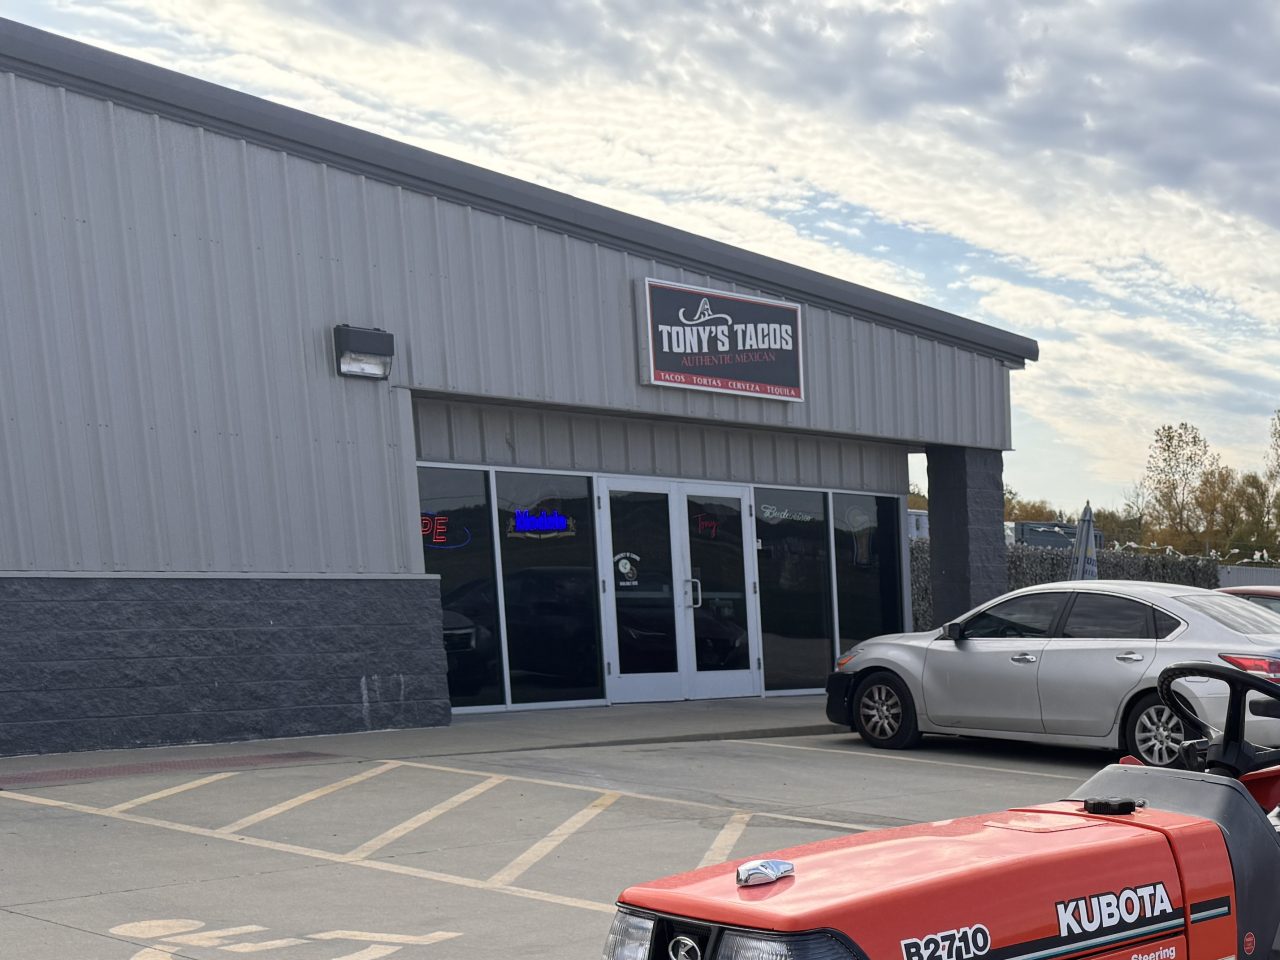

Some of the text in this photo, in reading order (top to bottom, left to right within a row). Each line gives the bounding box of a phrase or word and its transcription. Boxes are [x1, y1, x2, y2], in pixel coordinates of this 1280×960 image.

[658, 323, 793, 353] TONY'S TACOS
[735, 352, 776, 365] MEXICAN
[659, 372, 796, 396] TACOS TORTAS CERVEZA TEQUILA
[1056, 881, 1174, 938] KUBOTA
